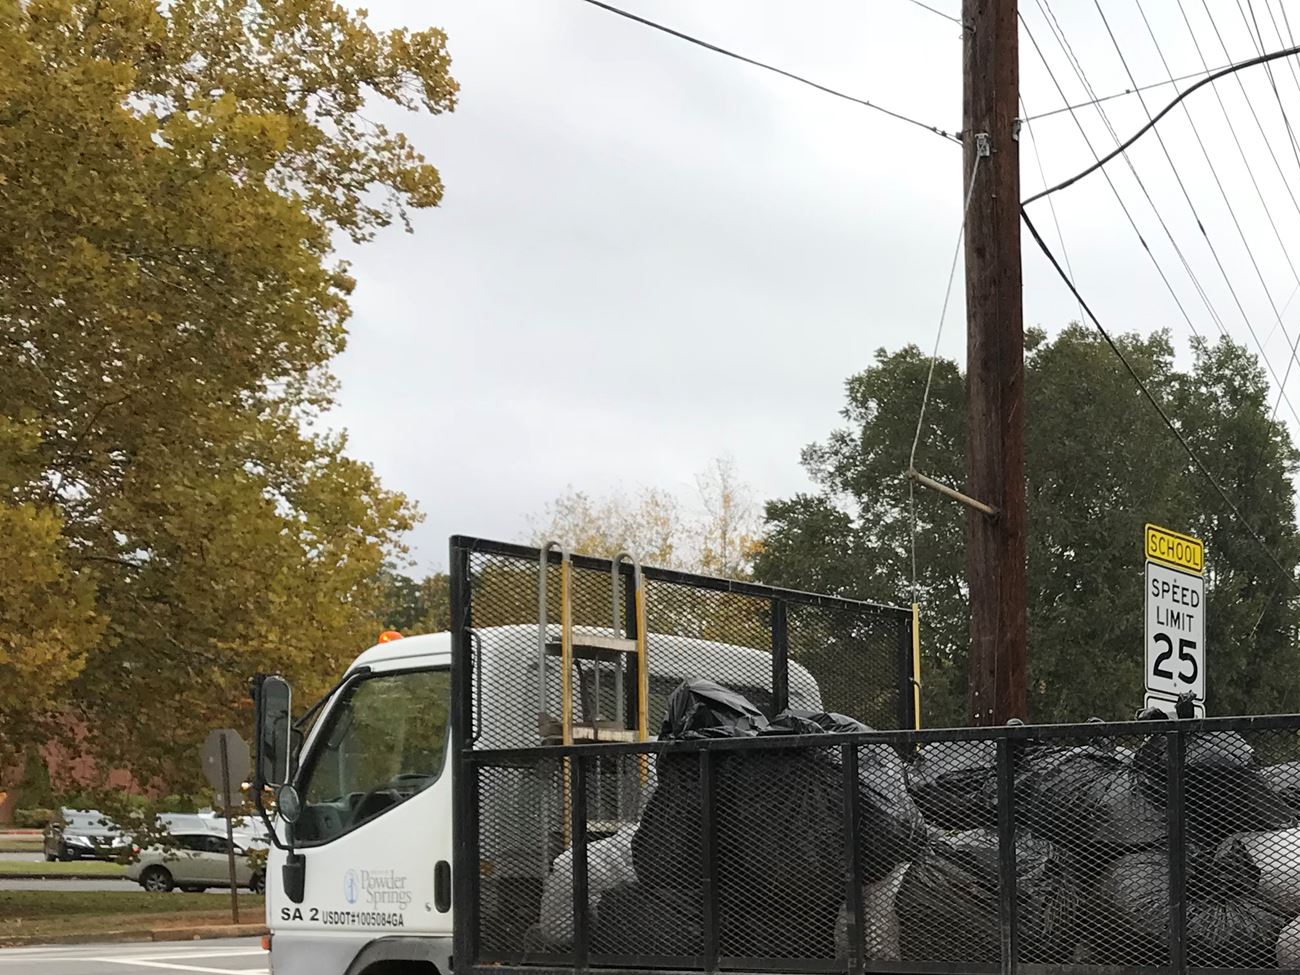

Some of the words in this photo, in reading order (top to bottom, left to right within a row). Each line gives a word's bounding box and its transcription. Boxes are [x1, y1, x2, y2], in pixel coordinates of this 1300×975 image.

[1150, 533, 1200, 567] SCHOOL
[1151, 578, 1200, 608] SPEED
[1156, 606, 1195, 633] LIMIT
[1153, 632, 1199, 685] 25
[360, 869, 407, 889] Powder
[366, 887, 413, 911] Springs
[280, 907, 303, 921] SA
[309, 907, 319, 921] 2
